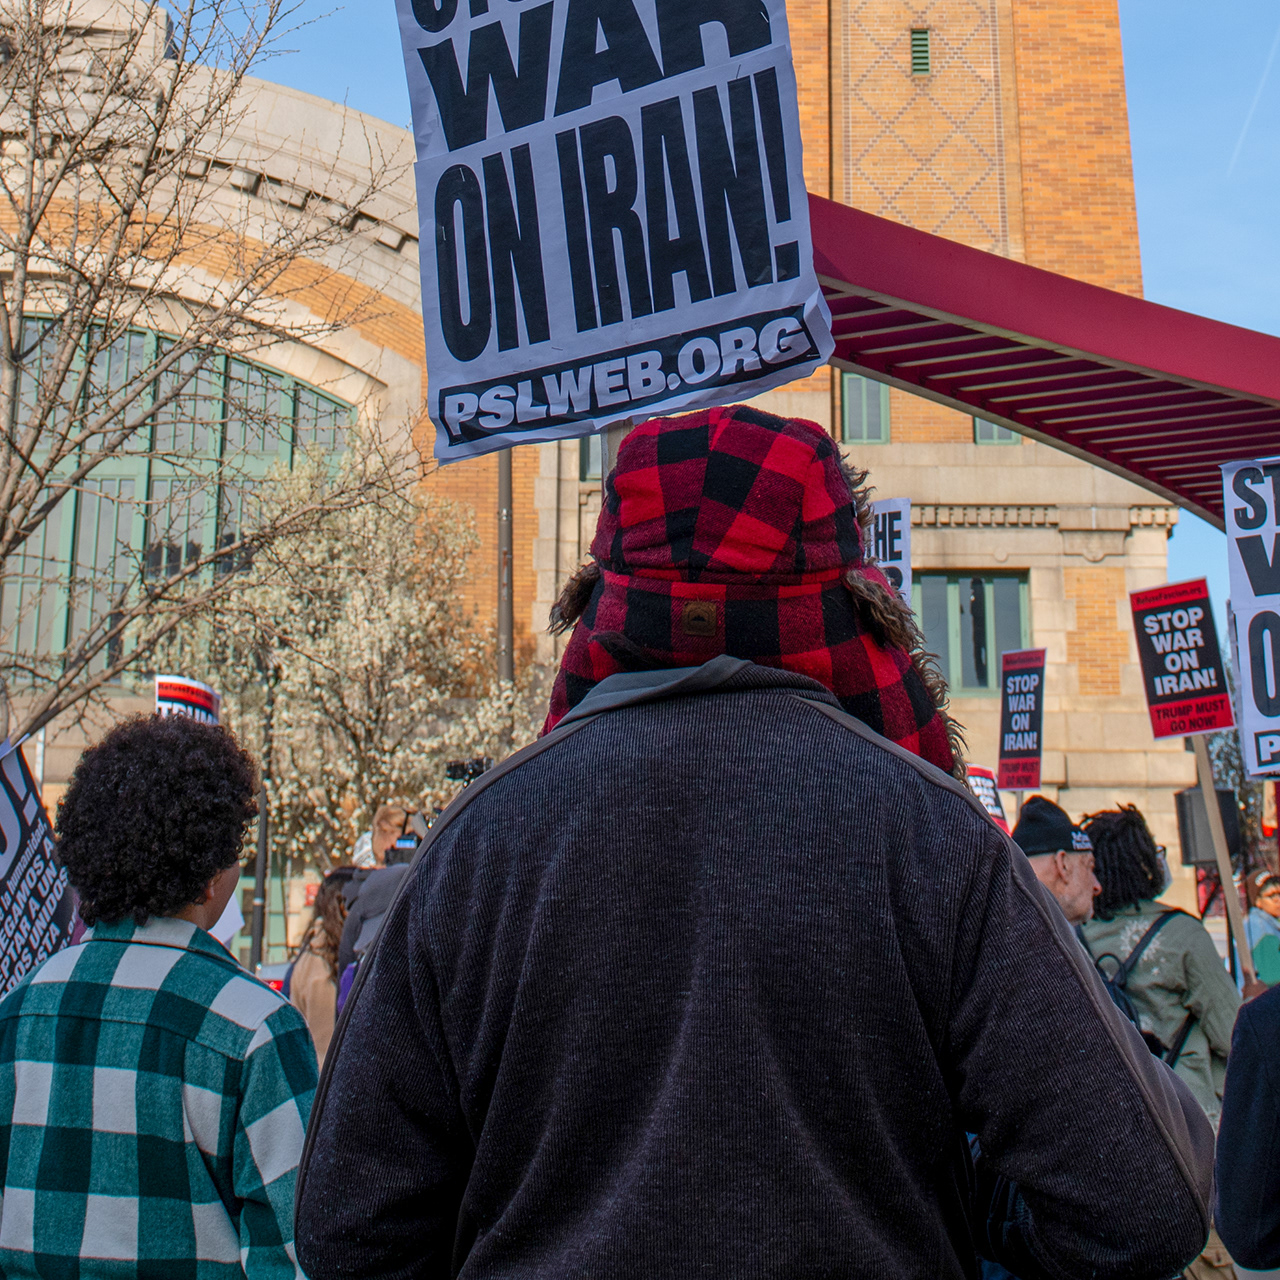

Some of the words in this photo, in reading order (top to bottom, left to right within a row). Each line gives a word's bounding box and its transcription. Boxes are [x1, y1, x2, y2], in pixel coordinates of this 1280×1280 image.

[434, 143, 553, 363] ON
[555, 66, 801, 333] IRAN!
[445, 315, 813, 437] PSLWEB.ORG
[866, 510, 903, 563] HE
[1143, 606, 1205, 635] STOP
[1150, 628, 1206, 655] WAR
[1164, 649, 1200, 673] ON
[1006, 673, 1040, 695] STOP
[1153, 667, 1218, 697] IRAN!
[1008, 693, 1036, 712] WAR
[1155, 703, 1194, 721] TRUMP
[1195, 699, 1226, 716] MUST
[1011, 713, 1030, 732] ON
[1170, 717, 1187, 733] GO
[1189, 714, 1218, 730] NOW!
[1004, 731, 1038, 752] IRAN!
[6, 817, 49, 892] humanidad,
[42, 836, 55, 858] A
[0, 892, 13, 911] la
[28, 895, 40, 921] A
[36, 859, 58, 899] UN
[28, 866, 69, 951] UNIDOS
